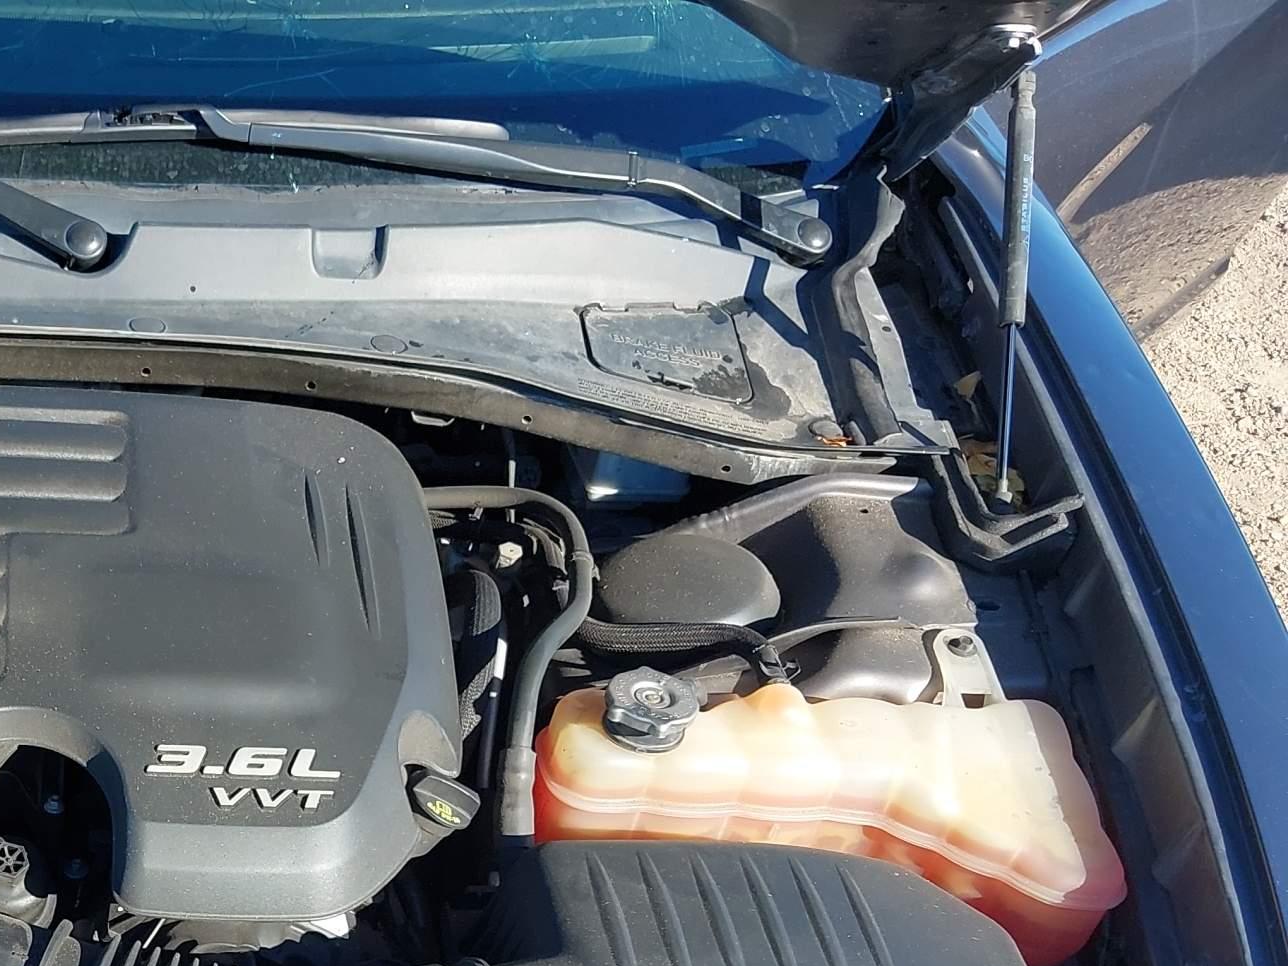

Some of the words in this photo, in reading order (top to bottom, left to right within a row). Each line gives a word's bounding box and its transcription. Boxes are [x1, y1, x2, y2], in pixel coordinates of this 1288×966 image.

[610, 334, 670, 353] BRAKE
[671, 344, 723, 360] FLUID
[633, 348, 703, 368] ACCESS
[144, 743, 342, 779] 3.6L
[209, 785, 335, 811] VVT
